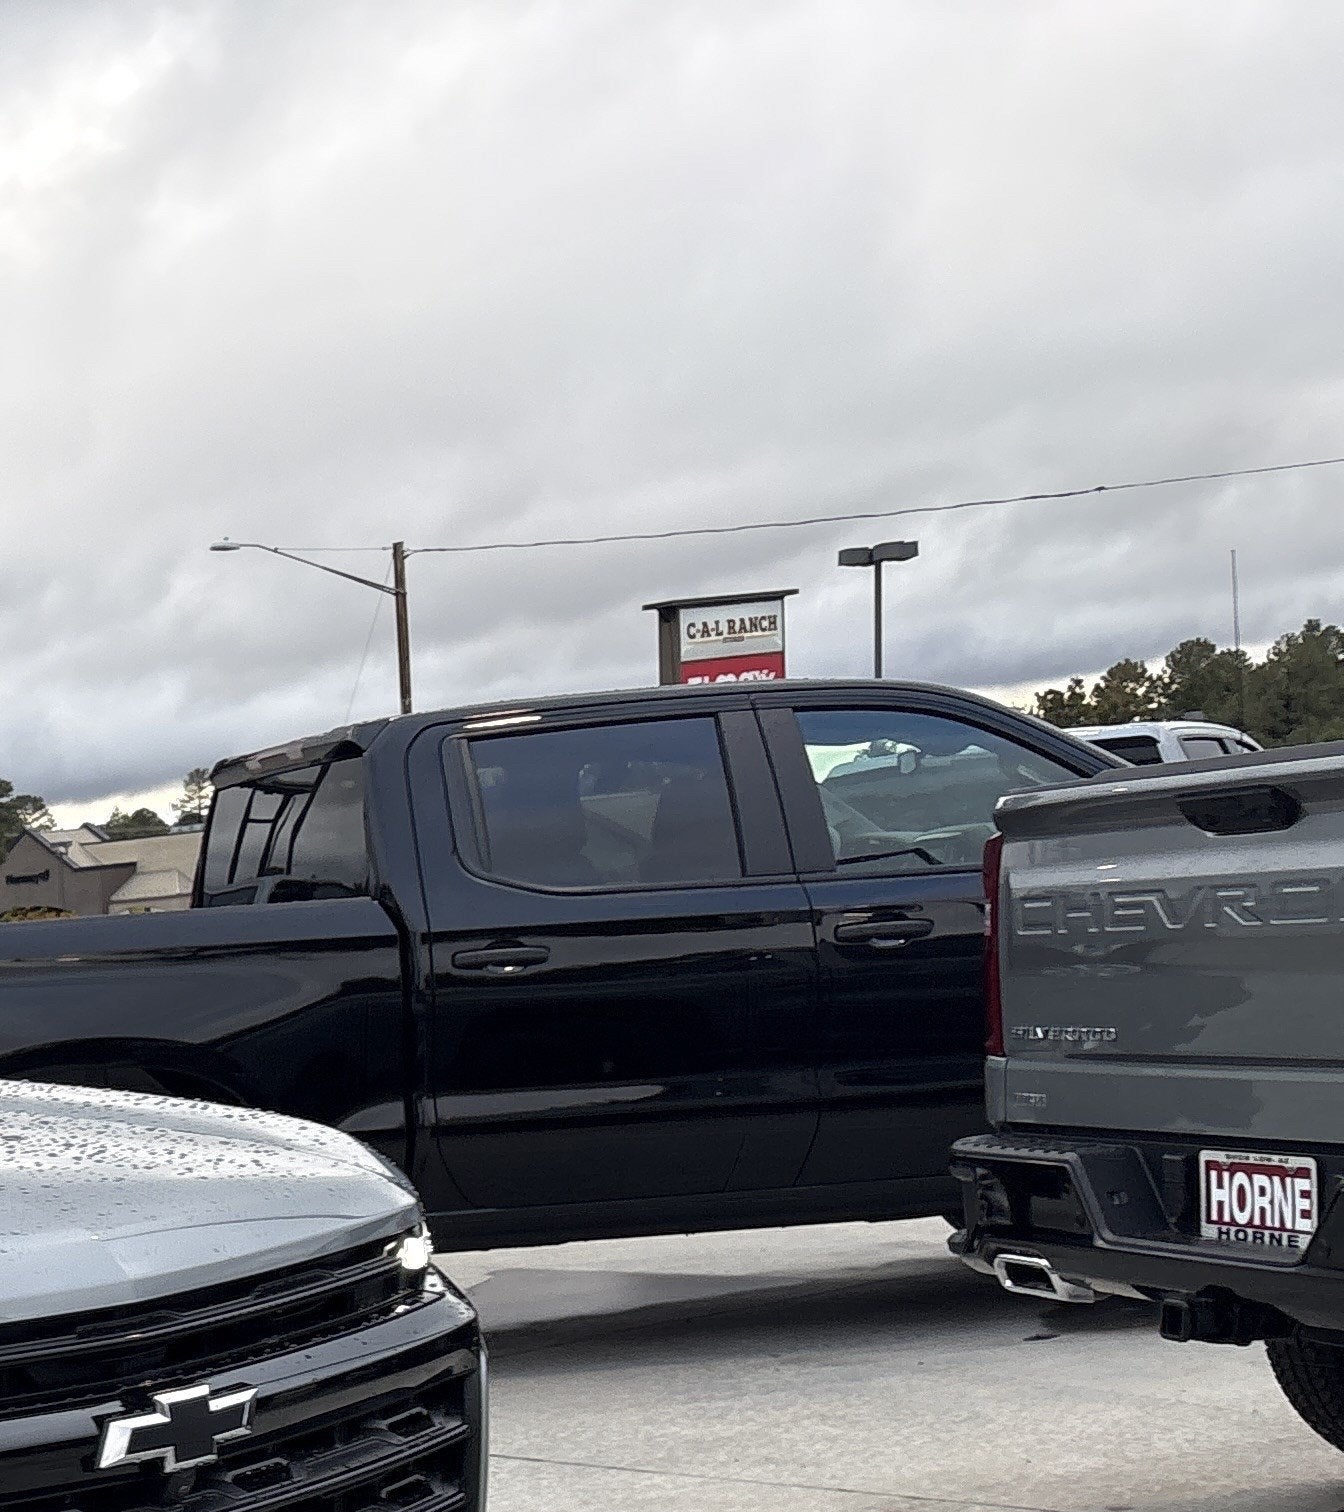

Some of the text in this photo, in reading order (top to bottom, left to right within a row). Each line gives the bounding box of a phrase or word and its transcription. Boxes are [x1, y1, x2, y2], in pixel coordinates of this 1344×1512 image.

[727, 614, 778, 635] RANCH
[1015, 880, 1344, 936] CHEVRO
[1209, 1169, 1313, 1232] HORNE
[1217, 1227, 1301, 1249] HORNE
